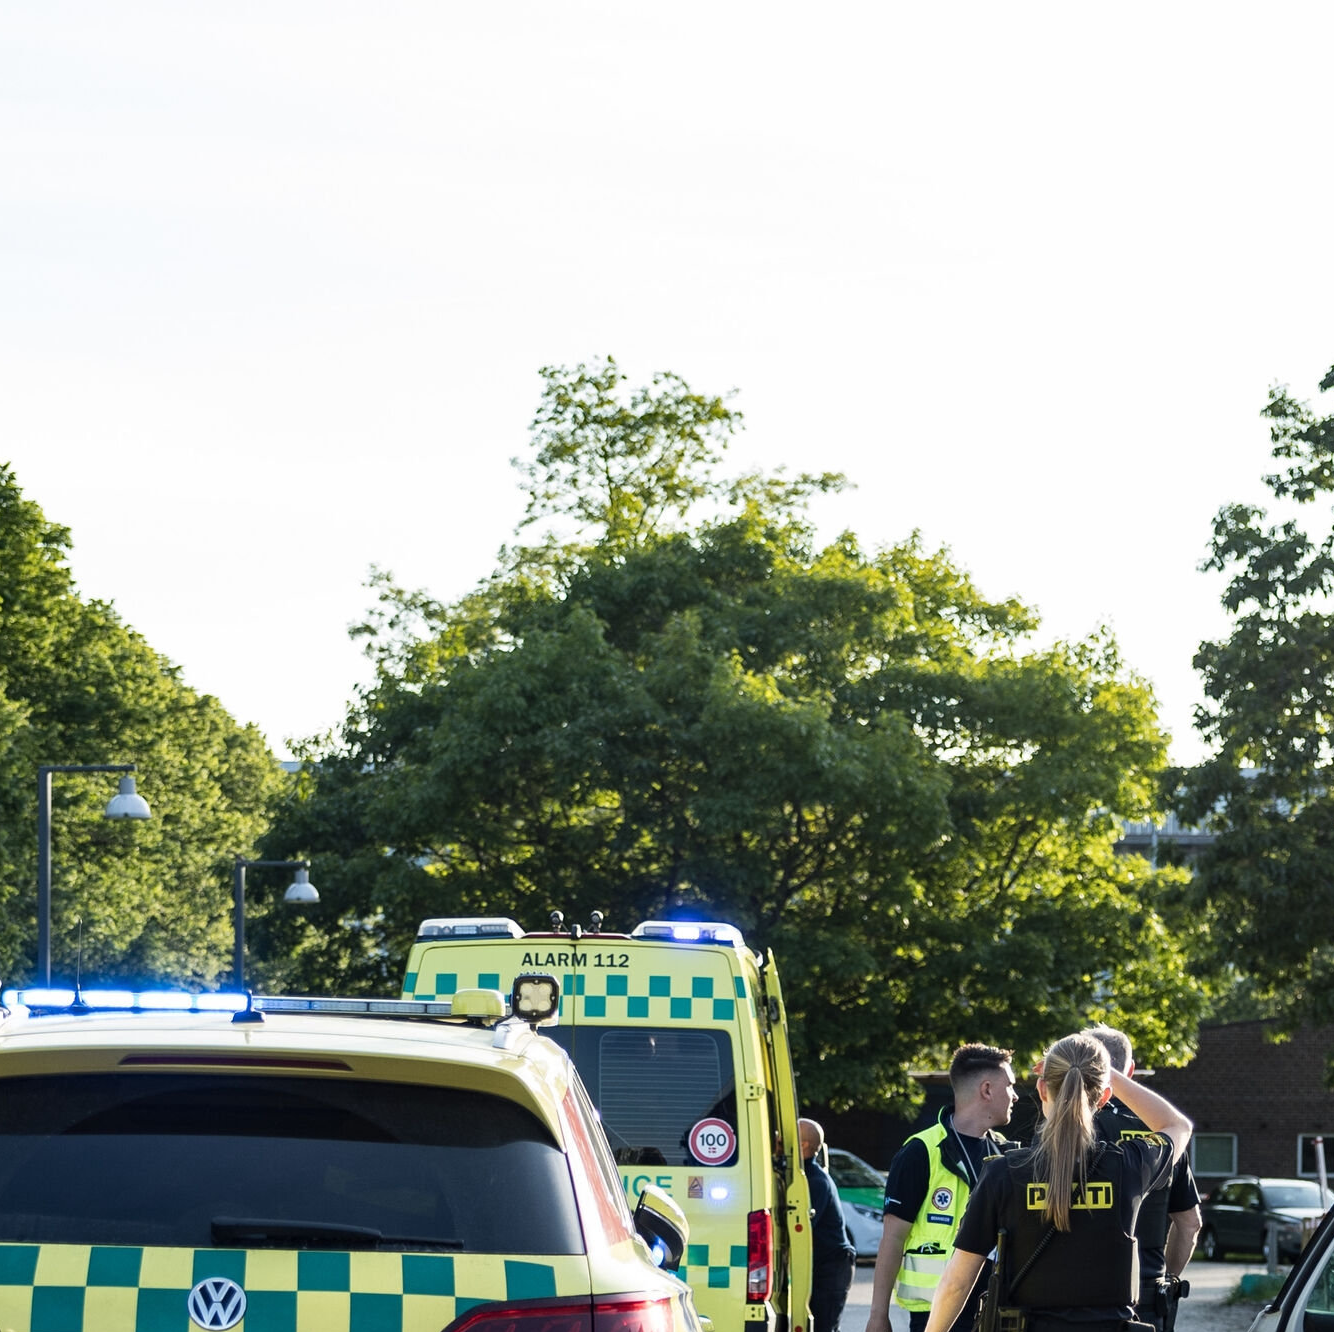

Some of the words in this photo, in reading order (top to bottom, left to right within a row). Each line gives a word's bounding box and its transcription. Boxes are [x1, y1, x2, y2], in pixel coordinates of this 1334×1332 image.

[521, 952, 587, 967] ALARM
[594, 953, 630, 968] 112
[699, 1133, 727, 1147] 100
